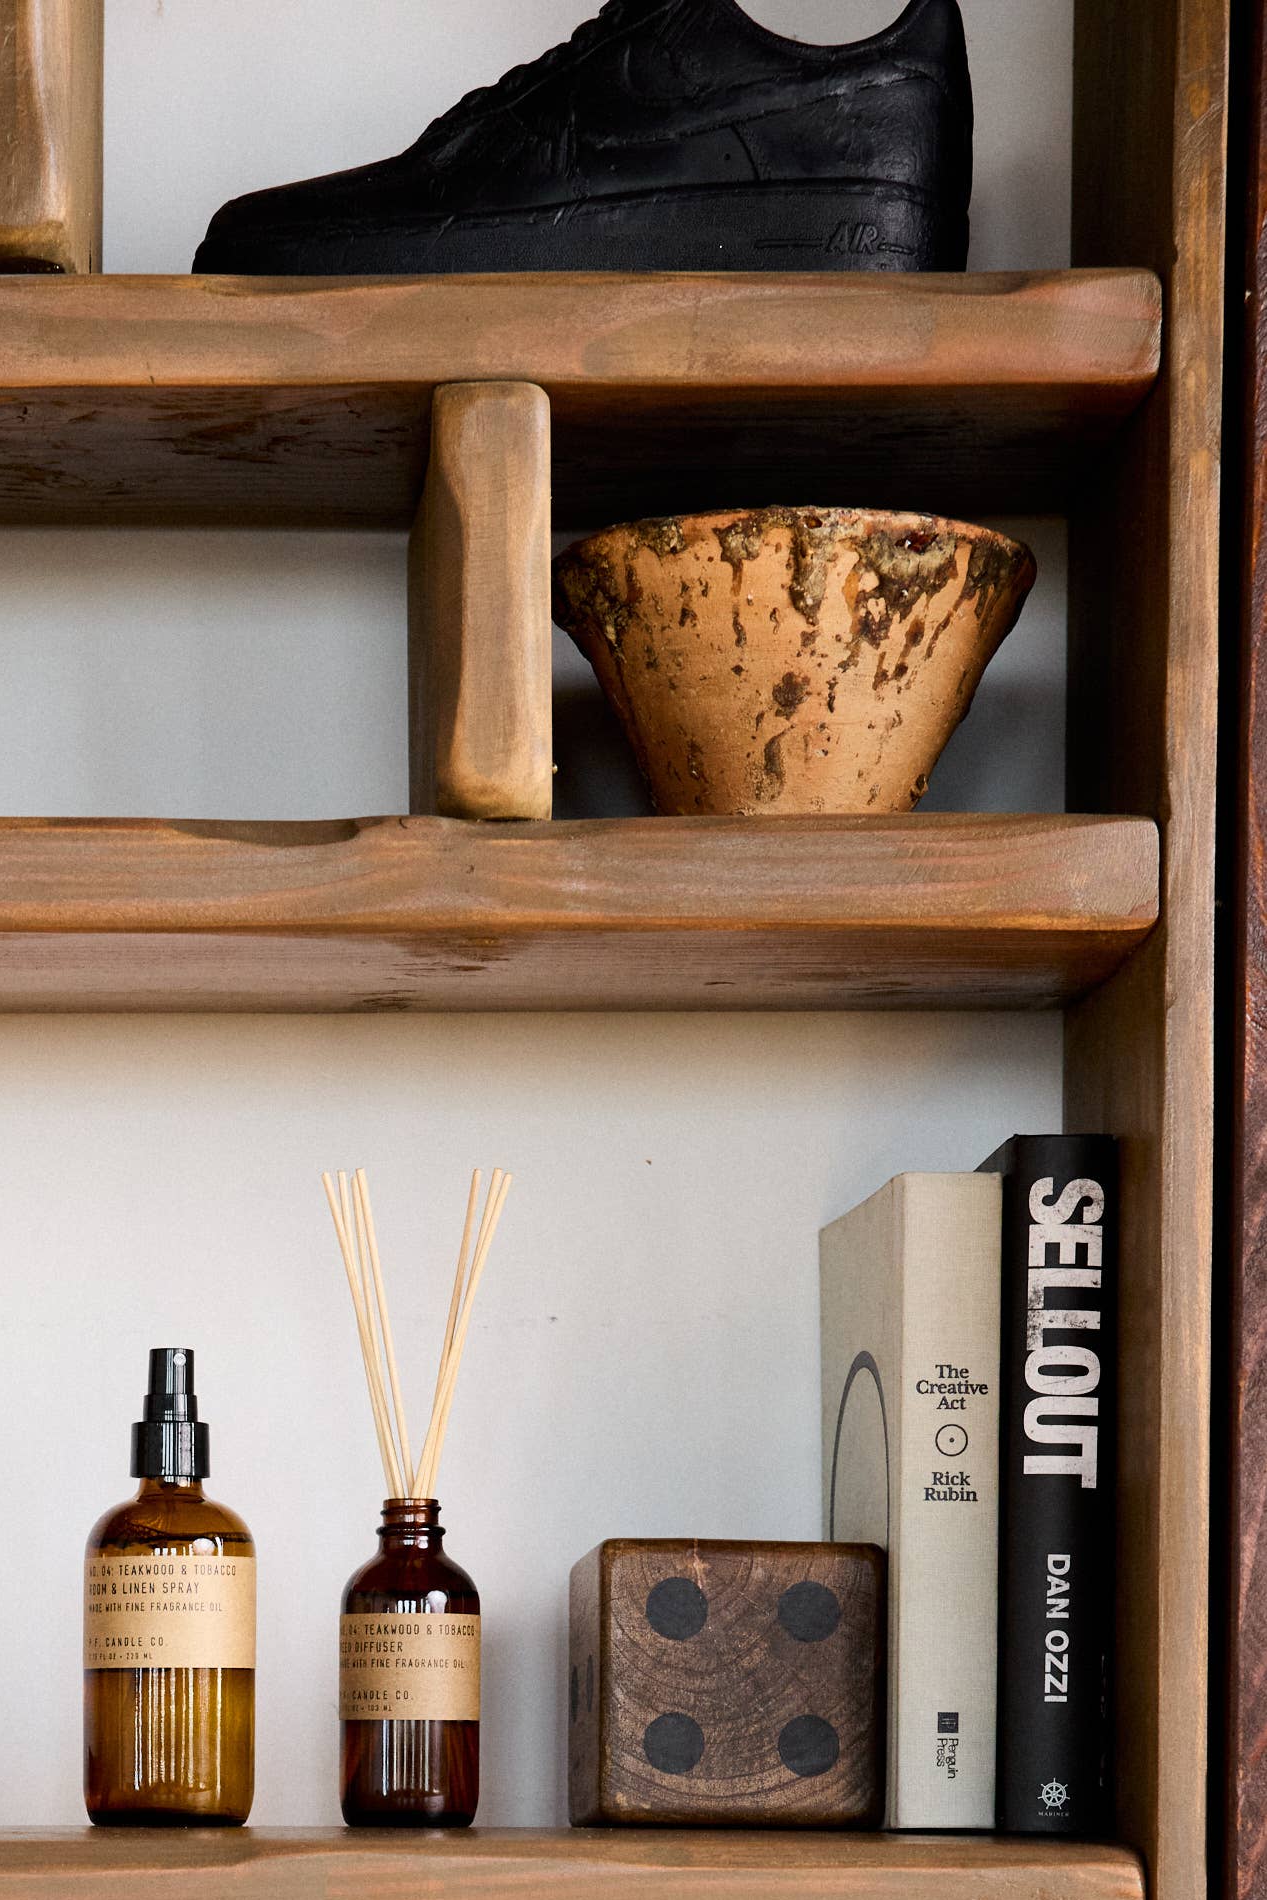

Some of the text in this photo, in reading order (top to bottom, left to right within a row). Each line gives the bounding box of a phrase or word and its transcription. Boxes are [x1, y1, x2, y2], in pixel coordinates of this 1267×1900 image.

[830, 223, 878, 254] AIR
[1023, 1176, 1105, 1489] SELLOUT
[935, 1364, 969, 1380] The
[916, 1380, 989, 1396] Creative
[936, 1396, 967, 1411] Act
[932, 1471, 971, 1487] Rick
[923, 1487, 979, 1502] Rubin
[119, 1564, 174, 1576] TEAKWOOD
[181, 1564, 188, 1576] &
[194, 1564, 237, 1577] TOBACCO
[111, 1583, 117, 1595] &
[122, 1582, 155, 1595] LINEN
[163, 1582, 200, 1594] SPRAY
[126, 1602, 145, 1612] FINE
[151, 1602, 205, 1612] FRAGRANCE
[364, 1624, 420, 1636] TEAKWOOD
[439, 1624, 475, 1637] TOBACCO
[1044, 1554, 1072, 1703] DAN OZZI
[105, 1637, 143, 1648] CANDLE
[355, 1641, 403, 1653] DIFFUSER
[371, 1658, 390, 1668] FINE
[395, 1658, 449, 1669] FRAGRANCE
[352, 1690, 388, 1700] CANDLE
[936, 1738, 948, 1768] Press
[947, 1738, 959, 1780] Penguin
